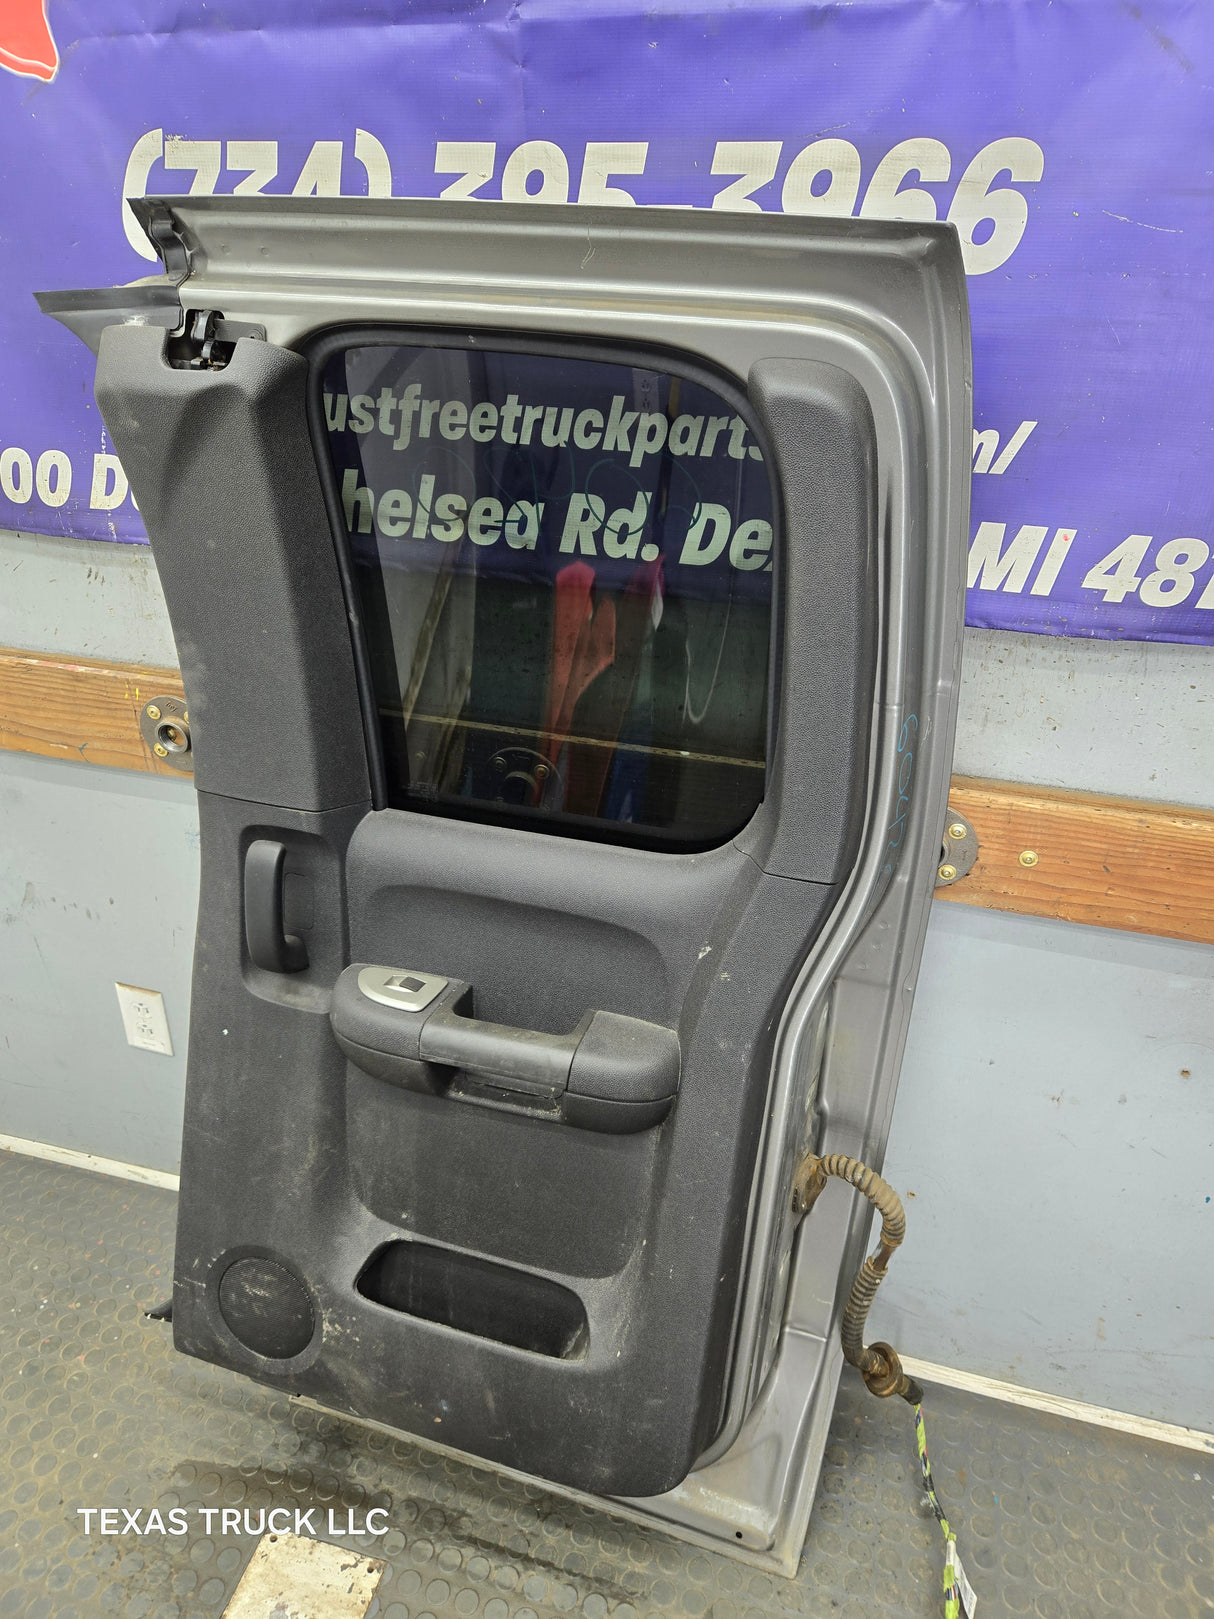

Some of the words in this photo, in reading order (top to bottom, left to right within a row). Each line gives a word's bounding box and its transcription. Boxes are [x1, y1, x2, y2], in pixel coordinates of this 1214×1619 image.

[90, 454, 140, 511] D
[559, 492, 660, 562] Rd.
[679, 502, 773, 572] De
[967, 522, 1078, 596] MI
